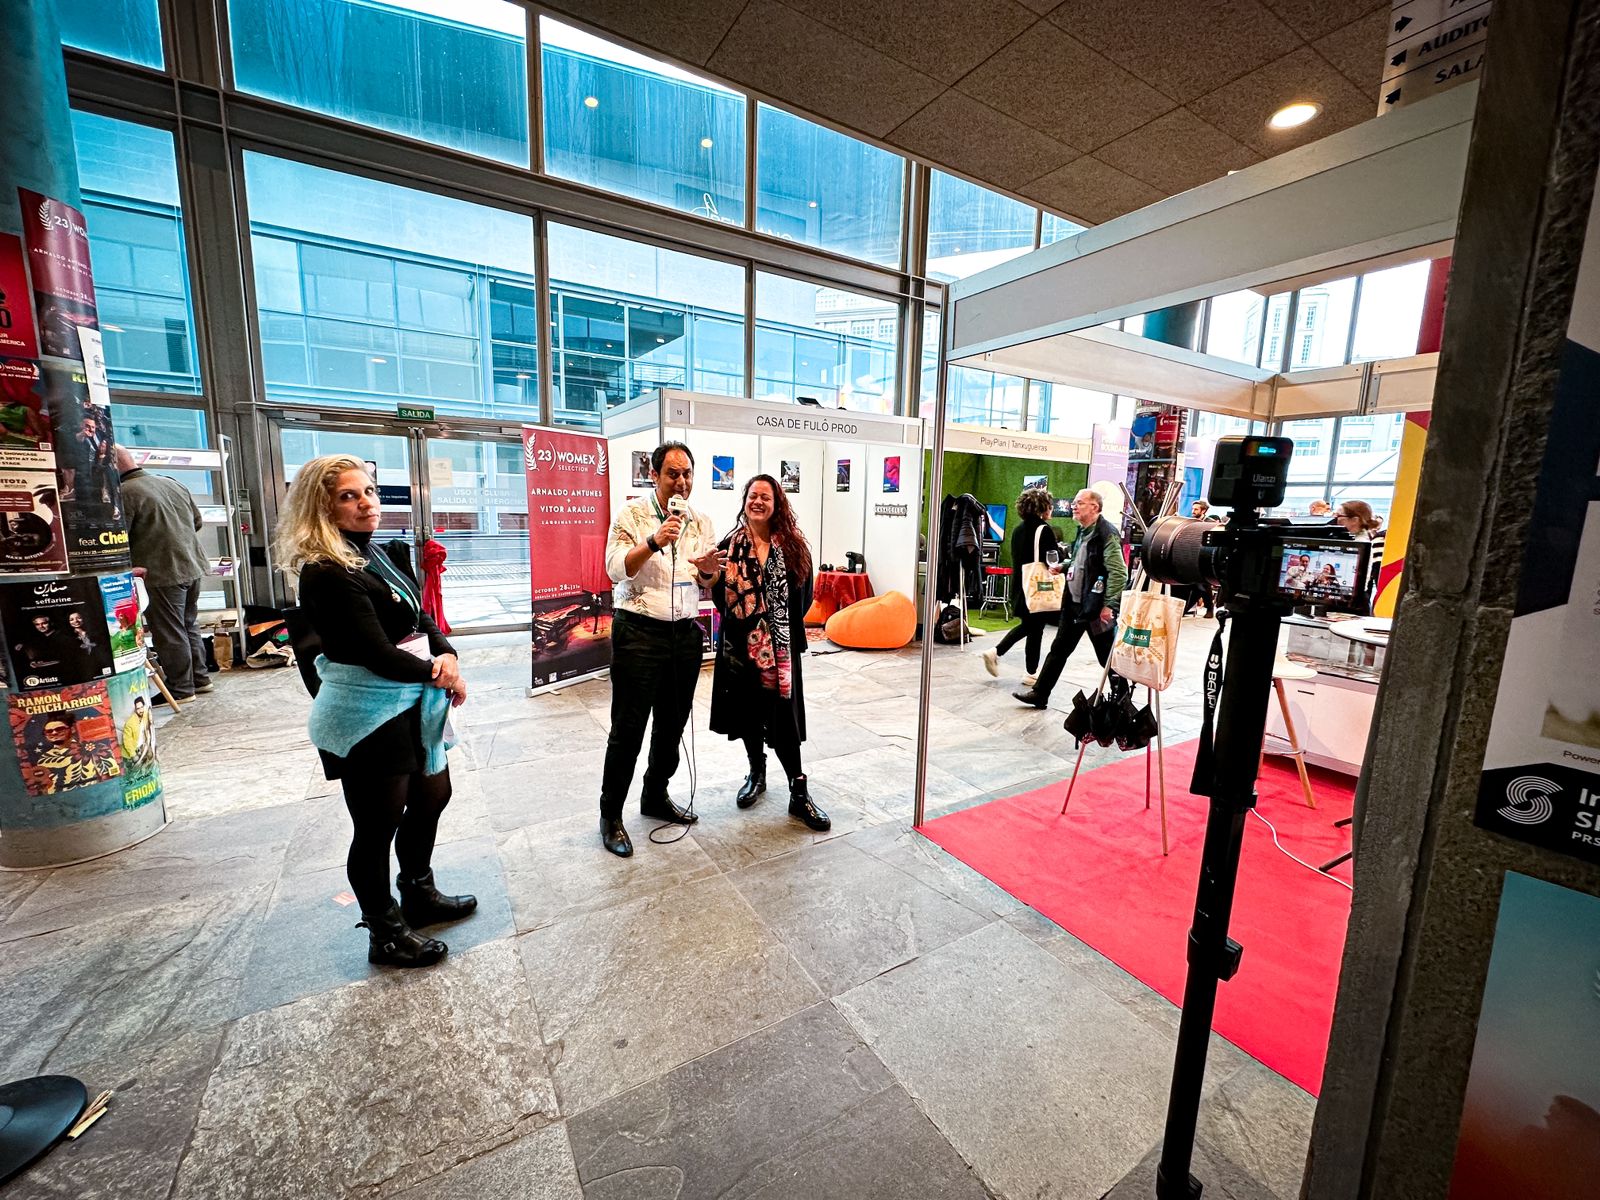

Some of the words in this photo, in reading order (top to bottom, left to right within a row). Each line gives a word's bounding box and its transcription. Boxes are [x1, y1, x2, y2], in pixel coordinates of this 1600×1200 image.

[0, 338, 26, 346] MERICA
[5, 365, 32, 373] WOMEX
[402, 409, 431, 419] SALIDA
[756, 416, 785, 428] CASA
[787, 418, 801, 429] DE
[803, 418, 829, 432] FULÔ
[832, 423, 858, 434] PROD
[980, 436, 1007, 448] PlayPlan
[557, 452, 596, 466] WOMEX
[531, 488, 568, 496] ARNALDO
[567, 504, 595, 513] ARAÚJO
[79, 538, 98, 546] feat.
[17, 694, 62, 708] RAMON
[26, 694, 102, 715] CHICHARRON
[125, 780, 158, 804] FRIDAY
